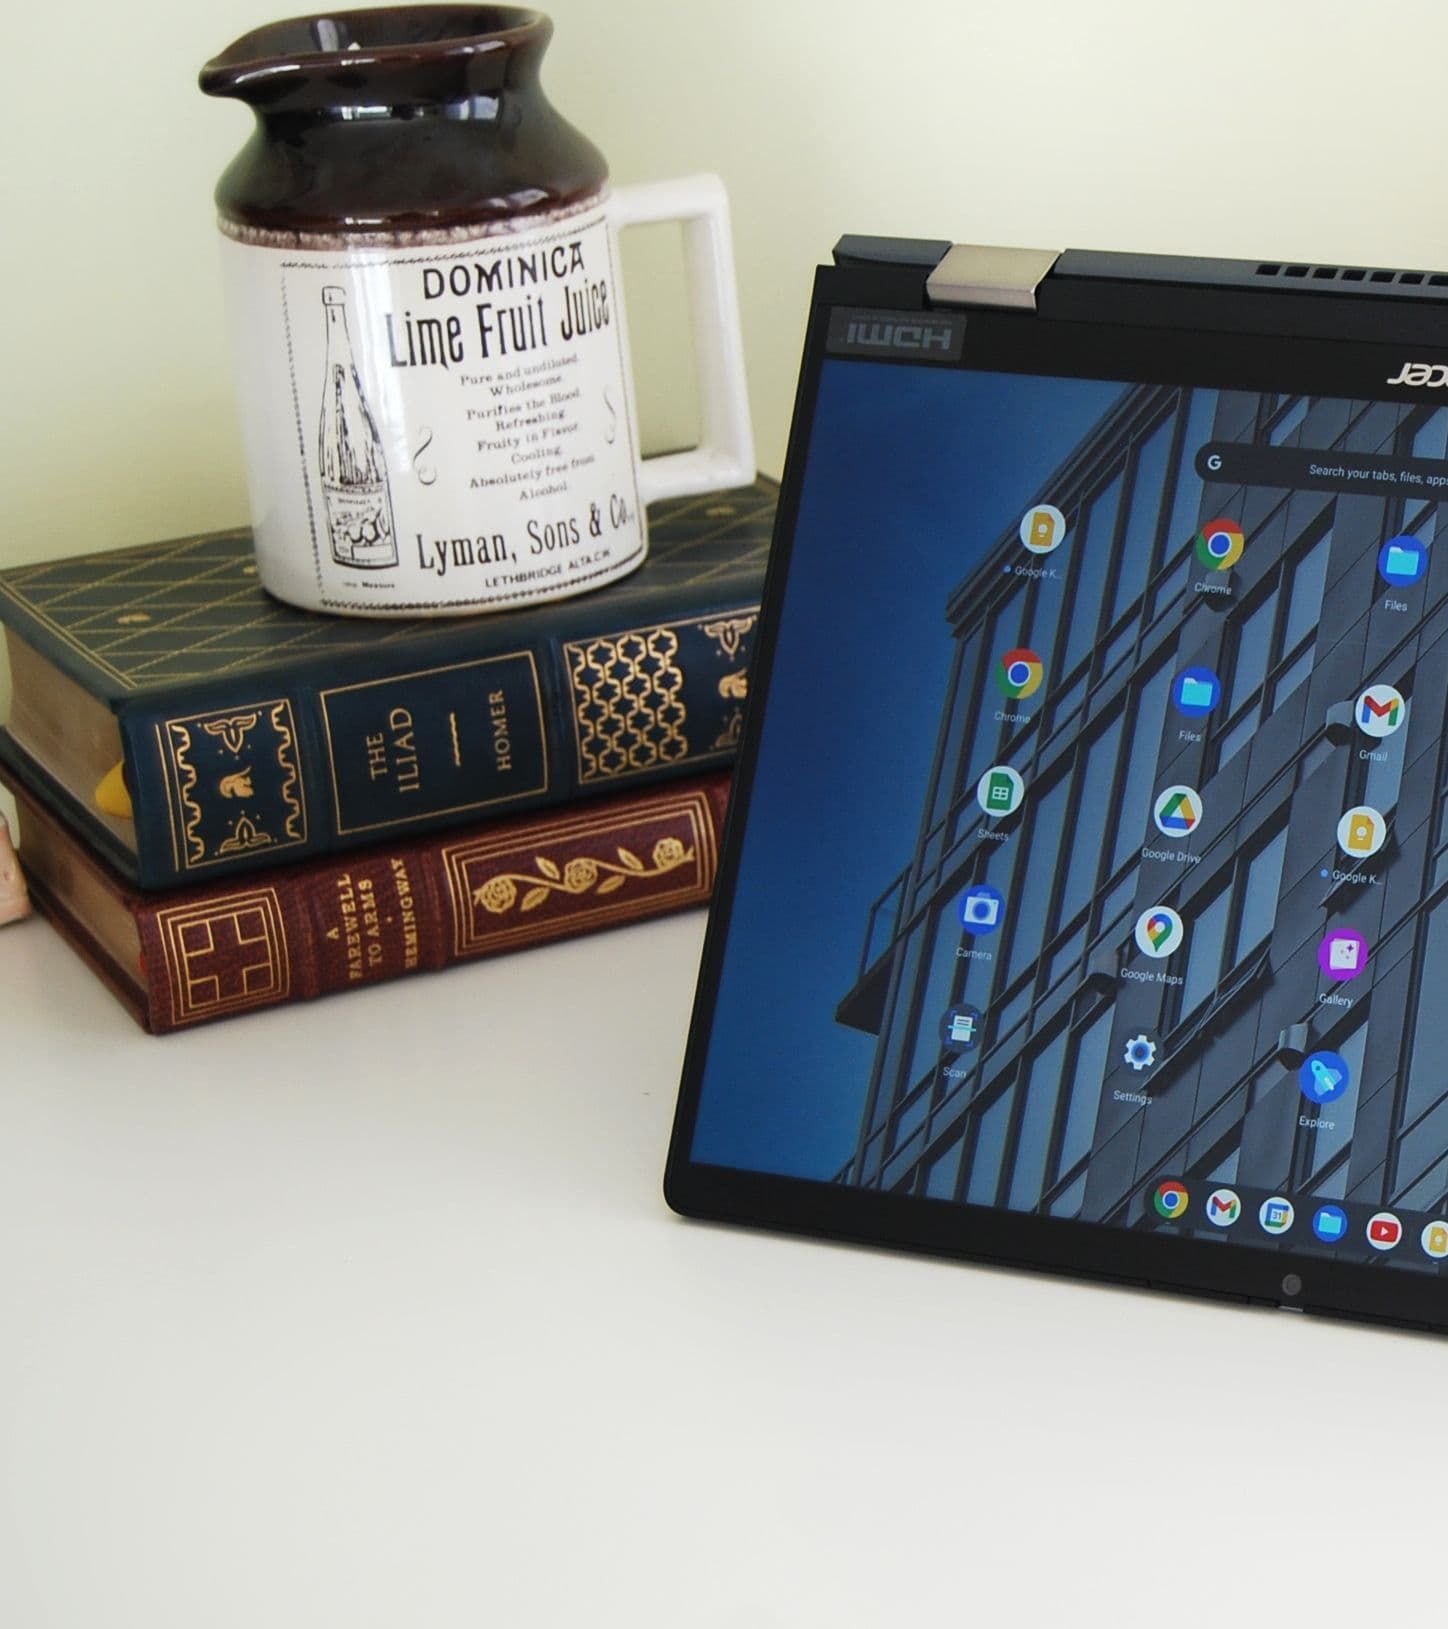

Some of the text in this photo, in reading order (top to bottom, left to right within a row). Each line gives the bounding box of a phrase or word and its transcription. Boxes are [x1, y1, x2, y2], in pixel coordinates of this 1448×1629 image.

[423, 241, 585, 300] DOMINICA
[385, 278, 610, 370] Lime Fruit Juice
[847, 322, 953, 350] HDMI
[460, 354, 578, 386] Pure and undiluted
[490, 375, 562, 397] Wholesome
[466, 388, 580, 420] Purifies the Blood
[496, 409, 565, 432] Refreshing
[477, 423, 578, 451] Fruity in Flavor
[511, 446, 561, 464] Cooling
[470, 454, 595, 489] Absolutely free from
[1309, 464, 1345, 479] Search
[1347, 469, 1371, 483] your
[1372, 469, 1398, 483] tabs,
[1400, 471, 1425, 485] files,
[519, 482, 568, 501] Alcohol
[416, 533, 518, 577] Lyman,
[527, 517, 580, 554] Sons
[589, 502, 602, 538] &
[485, 563, 562, 588] LETHBRIDGE
[1015, 566, 1048, 579] Google
[1194, 582, 1232, 596] Chrome
[1384, 599, 1408, 613] Files
[994, 711, 1031, 724] Chrome
[488, 689, 512, 771] HOMER
[1178, 729, 1202, 743] Files
[366, 732, 388, 781] THE
[389, 708, 420, 793] ILIAD
[1358, 748, 1388, 762] Gmail
[977, 827, 1010, 842] Sheets
[1141, 847, 1201, 864] Google Drive
[1332, 869, 1365, 885] Google
[358, 879, 382, 968] TO ARMS
[391, 858, 418, 969] HEMINGWAY
[326, 927, 339, 940] A
[338, 873, 362, 980] FAREWELL
[956, 947, 993, 961] Camera
[1120, 967, 1184, 987] Google Maps
[1318, 992, 1354, 1008] Gallery
[942, 1066, 967, 1079] Scan
[1112, 1089, 1153, 1105] Settings
[1298, 1116, 1335, 1132] Explore
